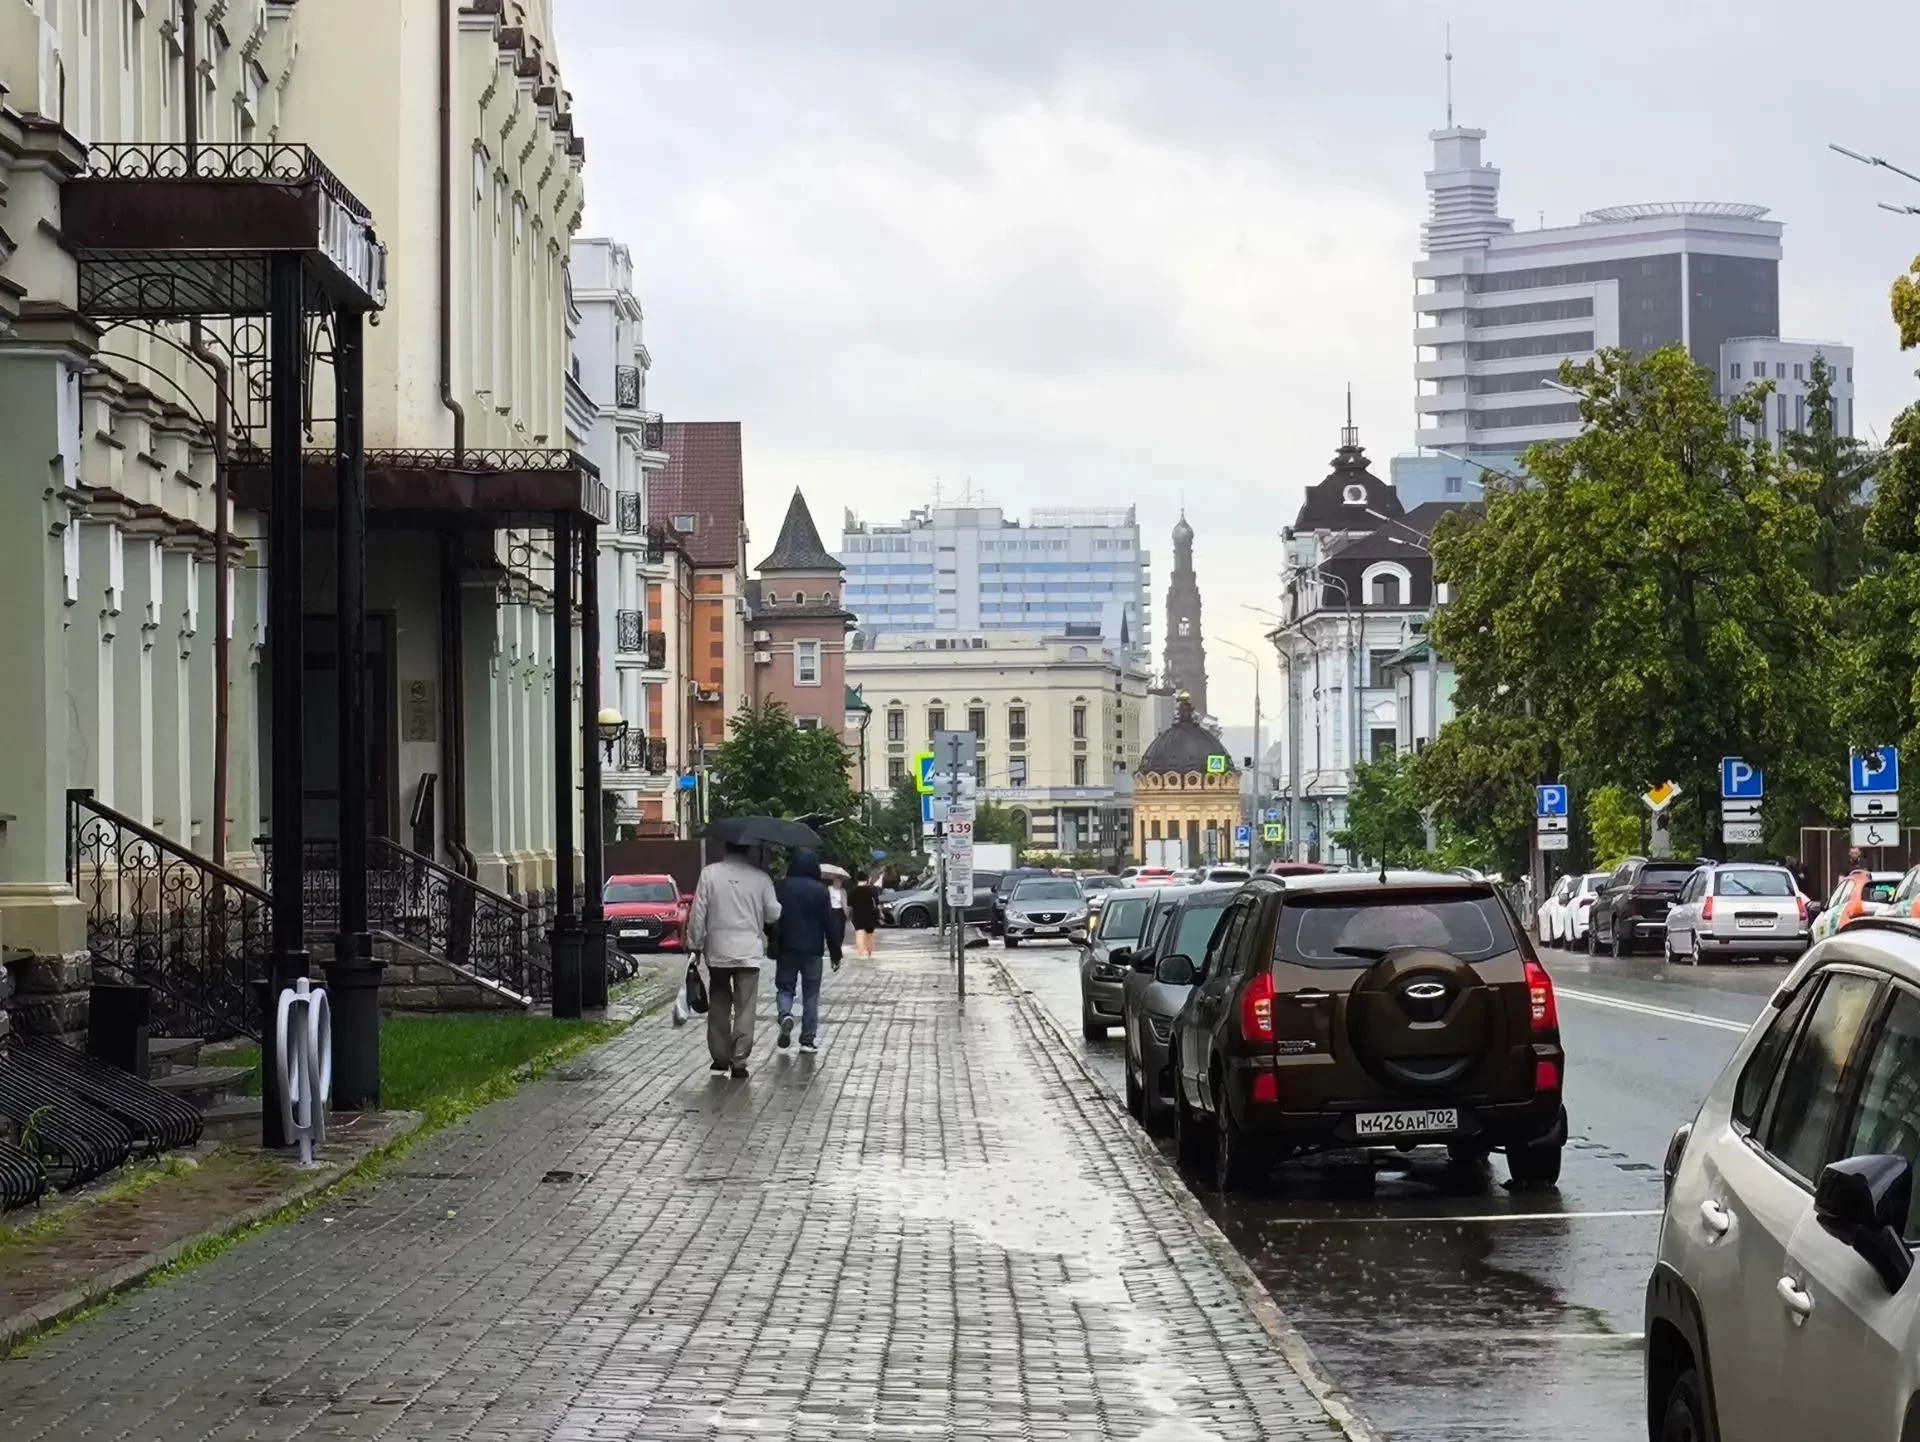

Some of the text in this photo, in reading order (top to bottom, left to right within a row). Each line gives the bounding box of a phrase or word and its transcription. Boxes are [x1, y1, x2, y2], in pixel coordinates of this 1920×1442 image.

[1731, 761, 1753, 793] P
[1861, 750, 1887, 787] P
[1543, 788, 1560, 812] P
[949, 823, 971, 834] 139
[1237, 827, 1247, 839] P
[1428, 1110, 1454, 1124] 702
